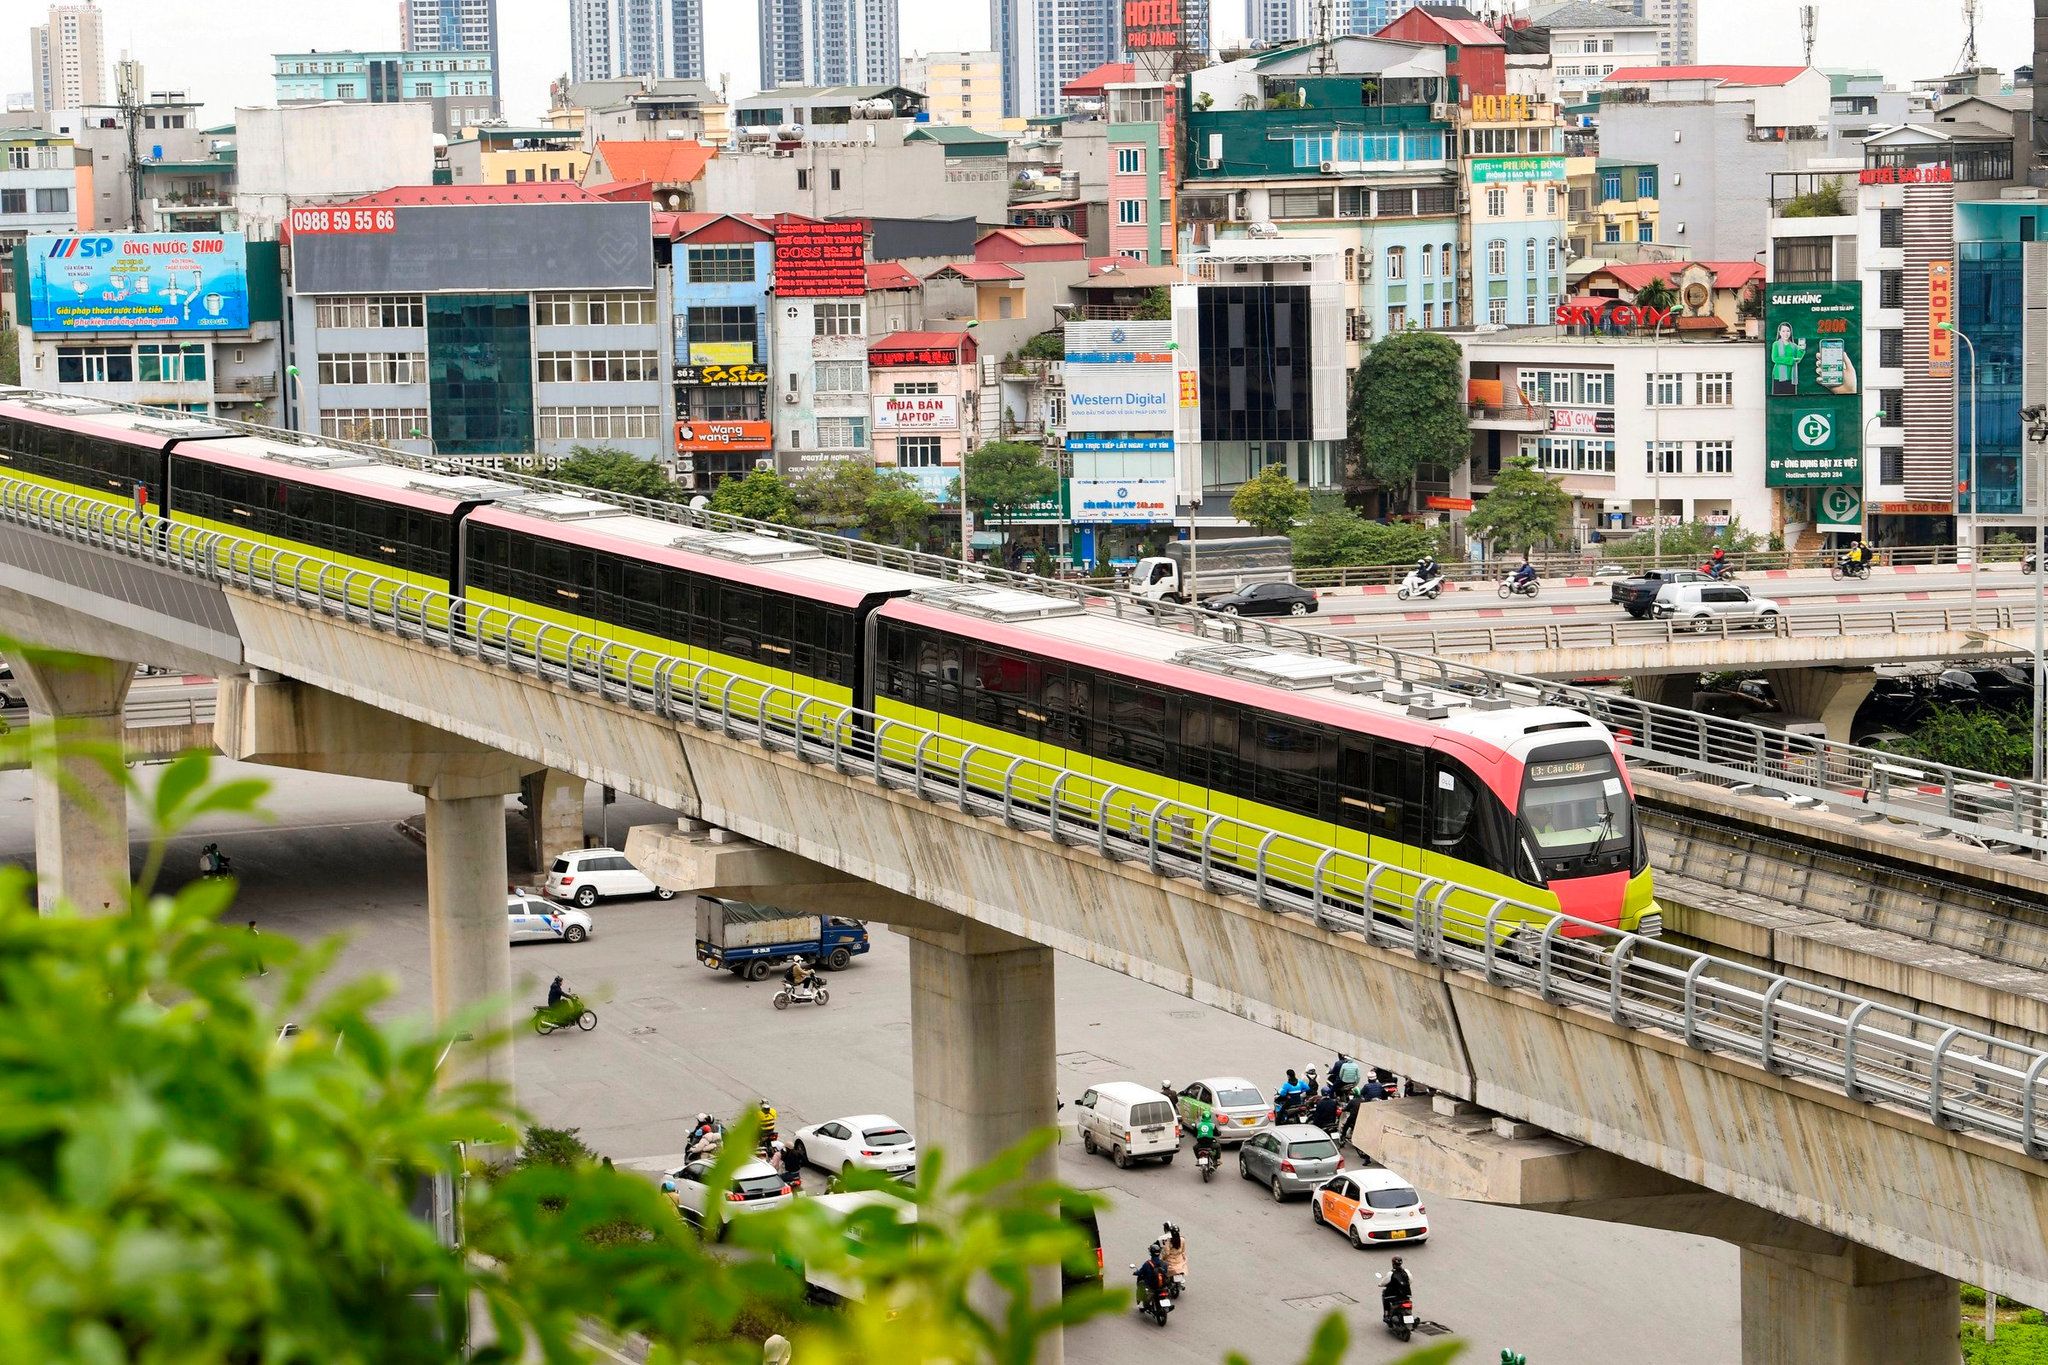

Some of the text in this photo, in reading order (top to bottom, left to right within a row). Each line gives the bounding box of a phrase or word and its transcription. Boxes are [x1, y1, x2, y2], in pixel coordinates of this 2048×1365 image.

[1126, 0, 1181, 26] HOTEL
[1472, 94, 1530, 120] HOTEL
[294, 210, 394, 231] 0988 59 55 66
[80, 238, 113, 257] SP
[123, 239, 224, 255] ỐNG NƯỚC SINO
[776, 247, 822, 258] GOSS
[1772, 292, 1822, 305] SALE KHỦNG
[1556, 305, 1671, 327] SKY GYM
[1932, 280, 1947, 356] HOTEL
[886, 398, 943, 410] MUA BÁN
[1071, 394, 1123, 406] Western
[1126, 392, 1166, 407] Digital
[897, 412, 935, 421] LAPTOP
[1557, 410, 1573, 426] SK
[1575, 413, 1594, 426] GYM
[709, 425, 743, 436] Wang
[699, 434, 729, 444] wang
[1885, 503, 1909, 512] HOTEL
